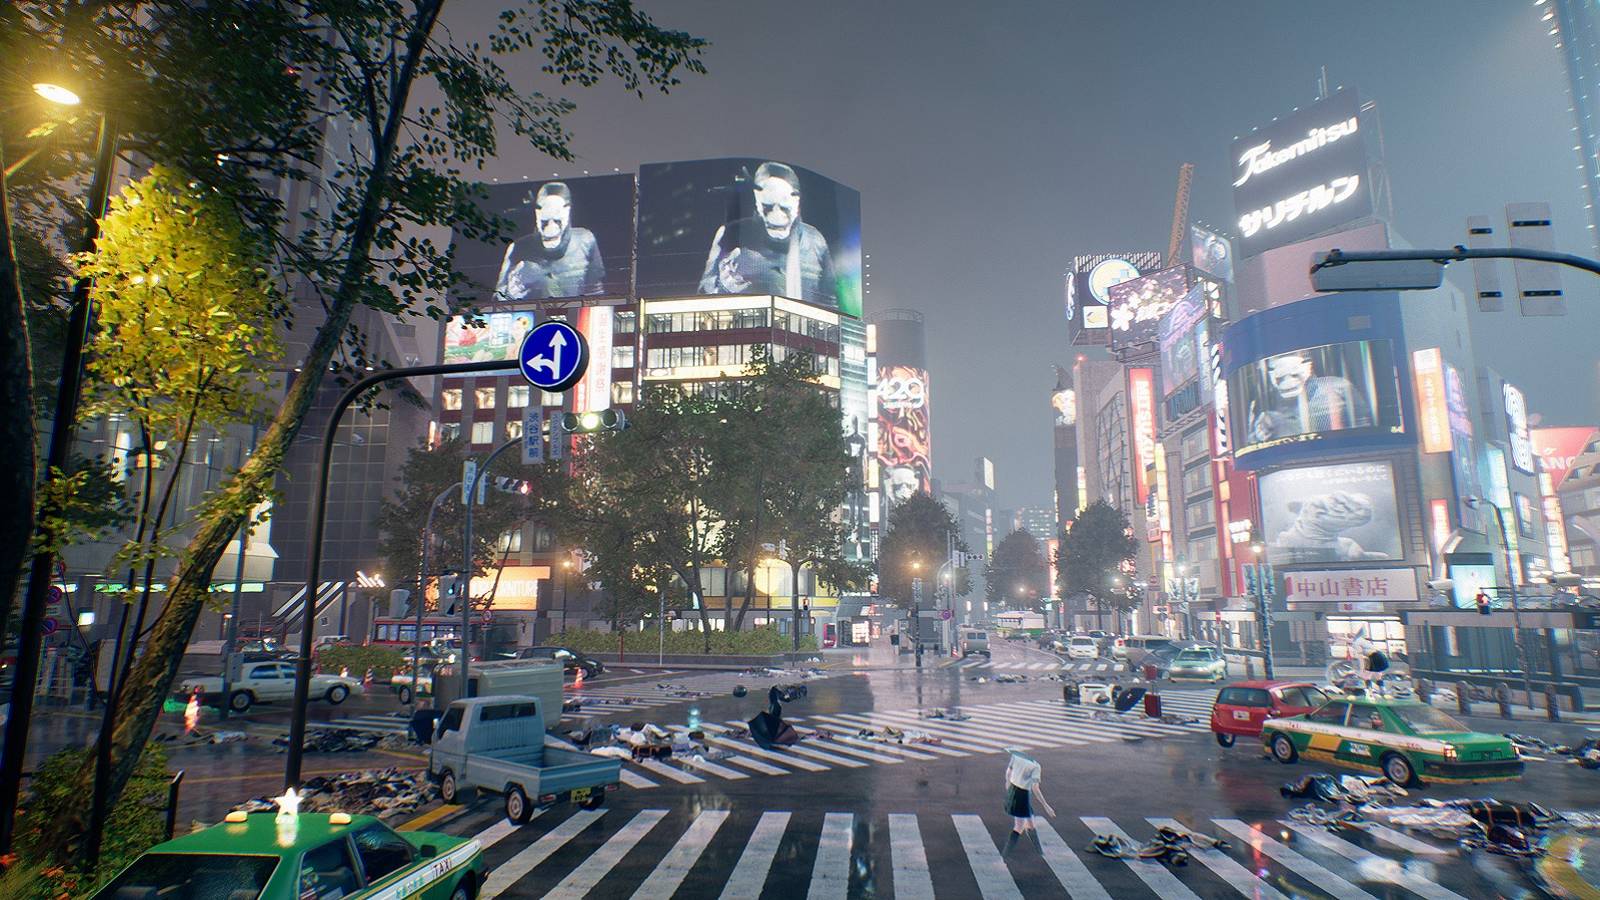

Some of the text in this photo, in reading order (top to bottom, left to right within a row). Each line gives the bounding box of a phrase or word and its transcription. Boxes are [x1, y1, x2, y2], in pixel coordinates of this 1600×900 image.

[1232, 116, 1359, 188] Takemitsu
[877, 377, 925, 409] 429
[1297, 577, 1388, 597] 中山書店
[433, 857, 453, 878] TAXI
